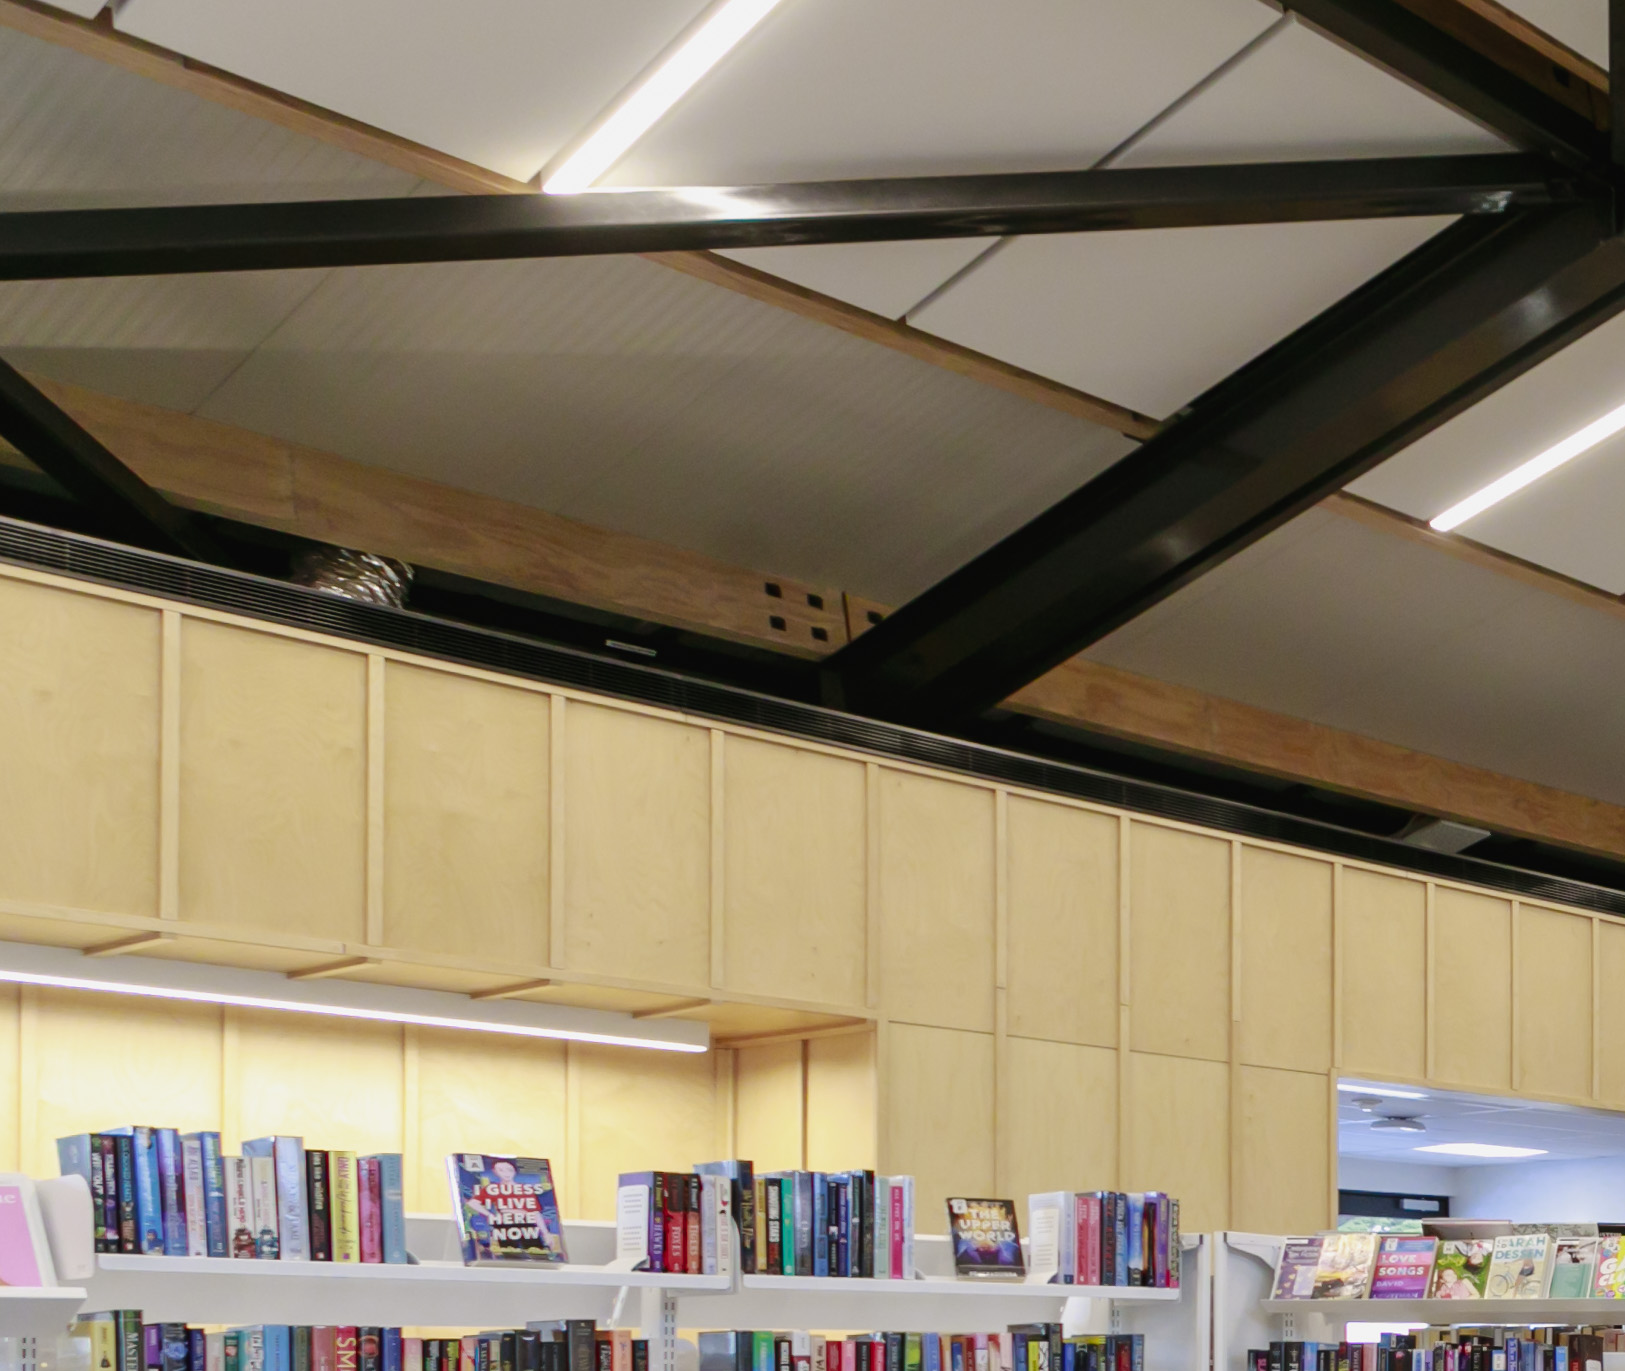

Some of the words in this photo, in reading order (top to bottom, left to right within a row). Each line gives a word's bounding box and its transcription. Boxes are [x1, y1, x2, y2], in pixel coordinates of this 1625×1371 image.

[474, 1185, 480, 1195] I
[486, 1184, 544, 1195] GUESS
[485, 1198, 491, 1209] I
[498, 1198, 536, 1209] LIVE
[489, 1214, 536, 1225] HERE
[971, 1209, 1000, 1219] THE
[959, 1219, 1011, 1230] UPPER
[493, 1228, 540, 1240] NOW
[769, 1221, 779, 1242] STARS
[959, 1231, 1015, 1242] WORLD
[653, 1224, 662, 1254] HAWKS
[671, 1226, 681, 1256] FOXES
[689, 1225, 699, 1256] TIGERS
[1381, 1254, 1416, 1263] LOVE
[1495, 1249, 1544, 1260] DESSEN
[1378, 1267, 1424, 1276] SONGS
